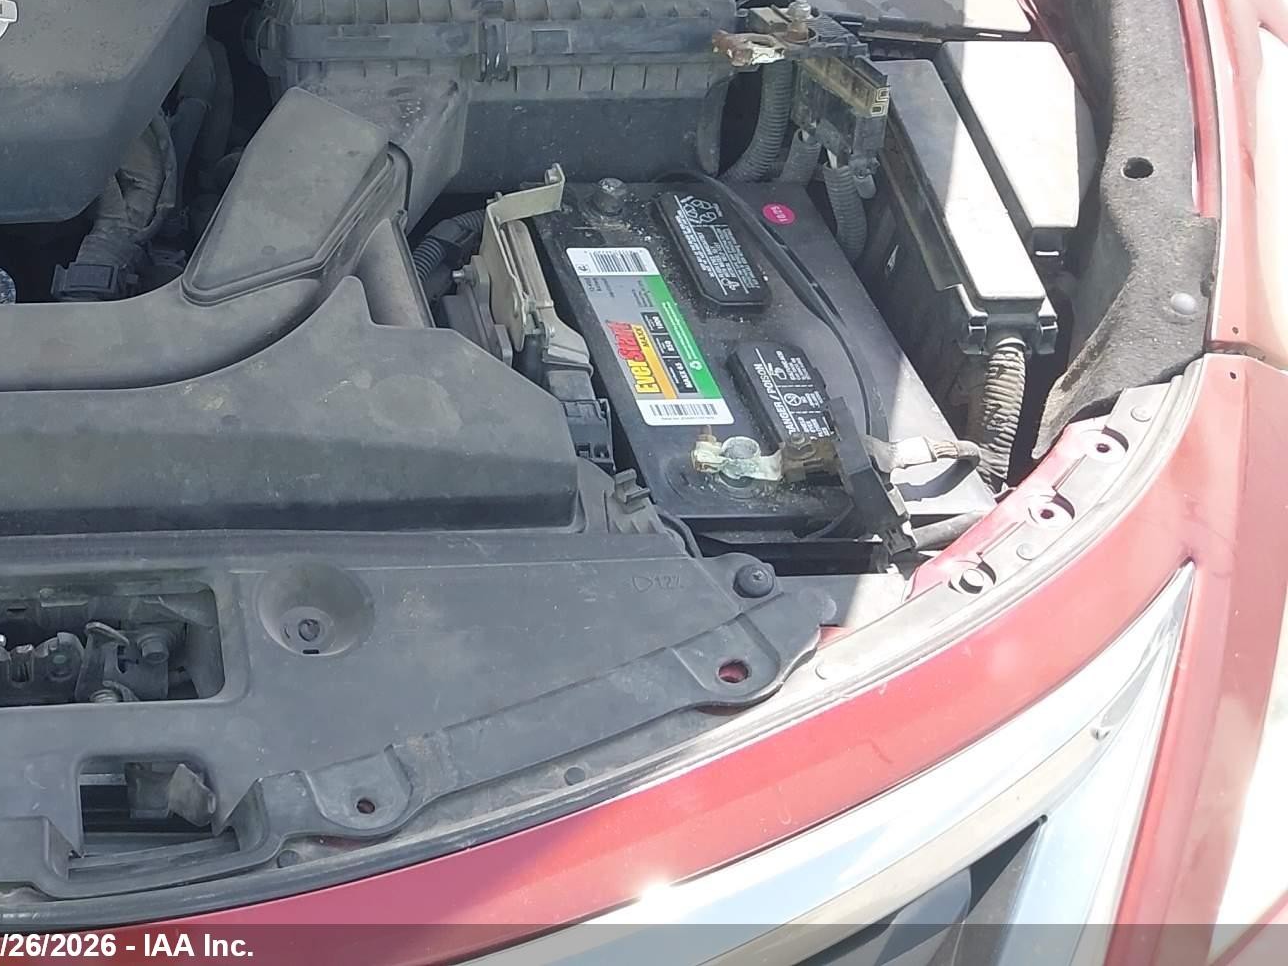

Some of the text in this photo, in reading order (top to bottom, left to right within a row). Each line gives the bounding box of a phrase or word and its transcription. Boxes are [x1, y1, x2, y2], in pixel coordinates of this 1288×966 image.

[634, 326, 650, 348] MAXX
[608, 321, 663, 394] EverStart
[753, 363, 777, 394] POISON
